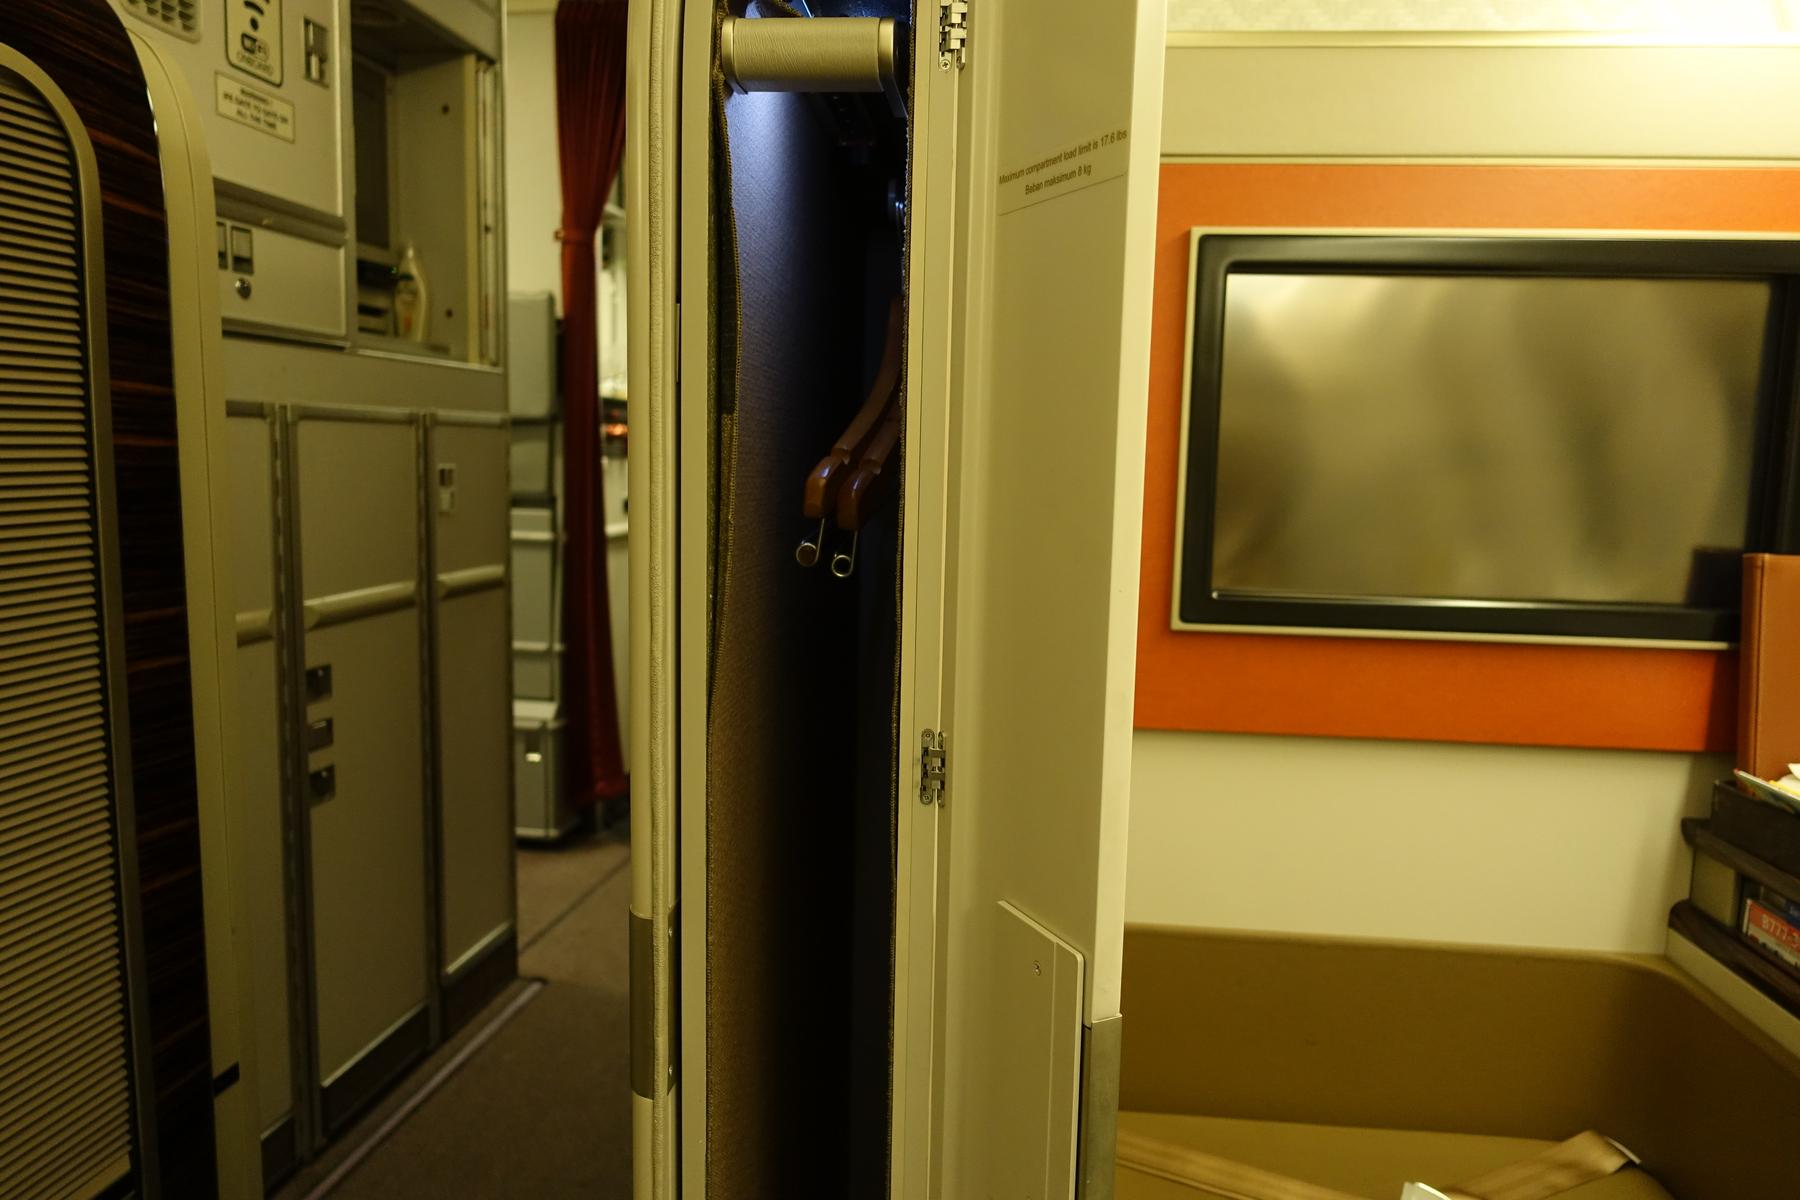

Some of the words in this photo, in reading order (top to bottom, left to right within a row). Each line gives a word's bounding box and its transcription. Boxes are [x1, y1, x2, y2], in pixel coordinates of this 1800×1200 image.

[999, 168, 1025, 185] Maximum
[1025, 153, 1063, 174] compartment
[1063, 148, 1077, 161] load
[1078, 142, 1092, 156] limit
[1092, 139, 1099, 150] is
[1101, 132, 1116, 148] 17.6
[1116, 129, 1128, 142] lbs
[1025, 182, 1044, 196] Beban
[1044, 169, 1077, 188] maksimum
[1077, 165, 1083, 177] 8
[1083, 164, 1092, 177] kg
